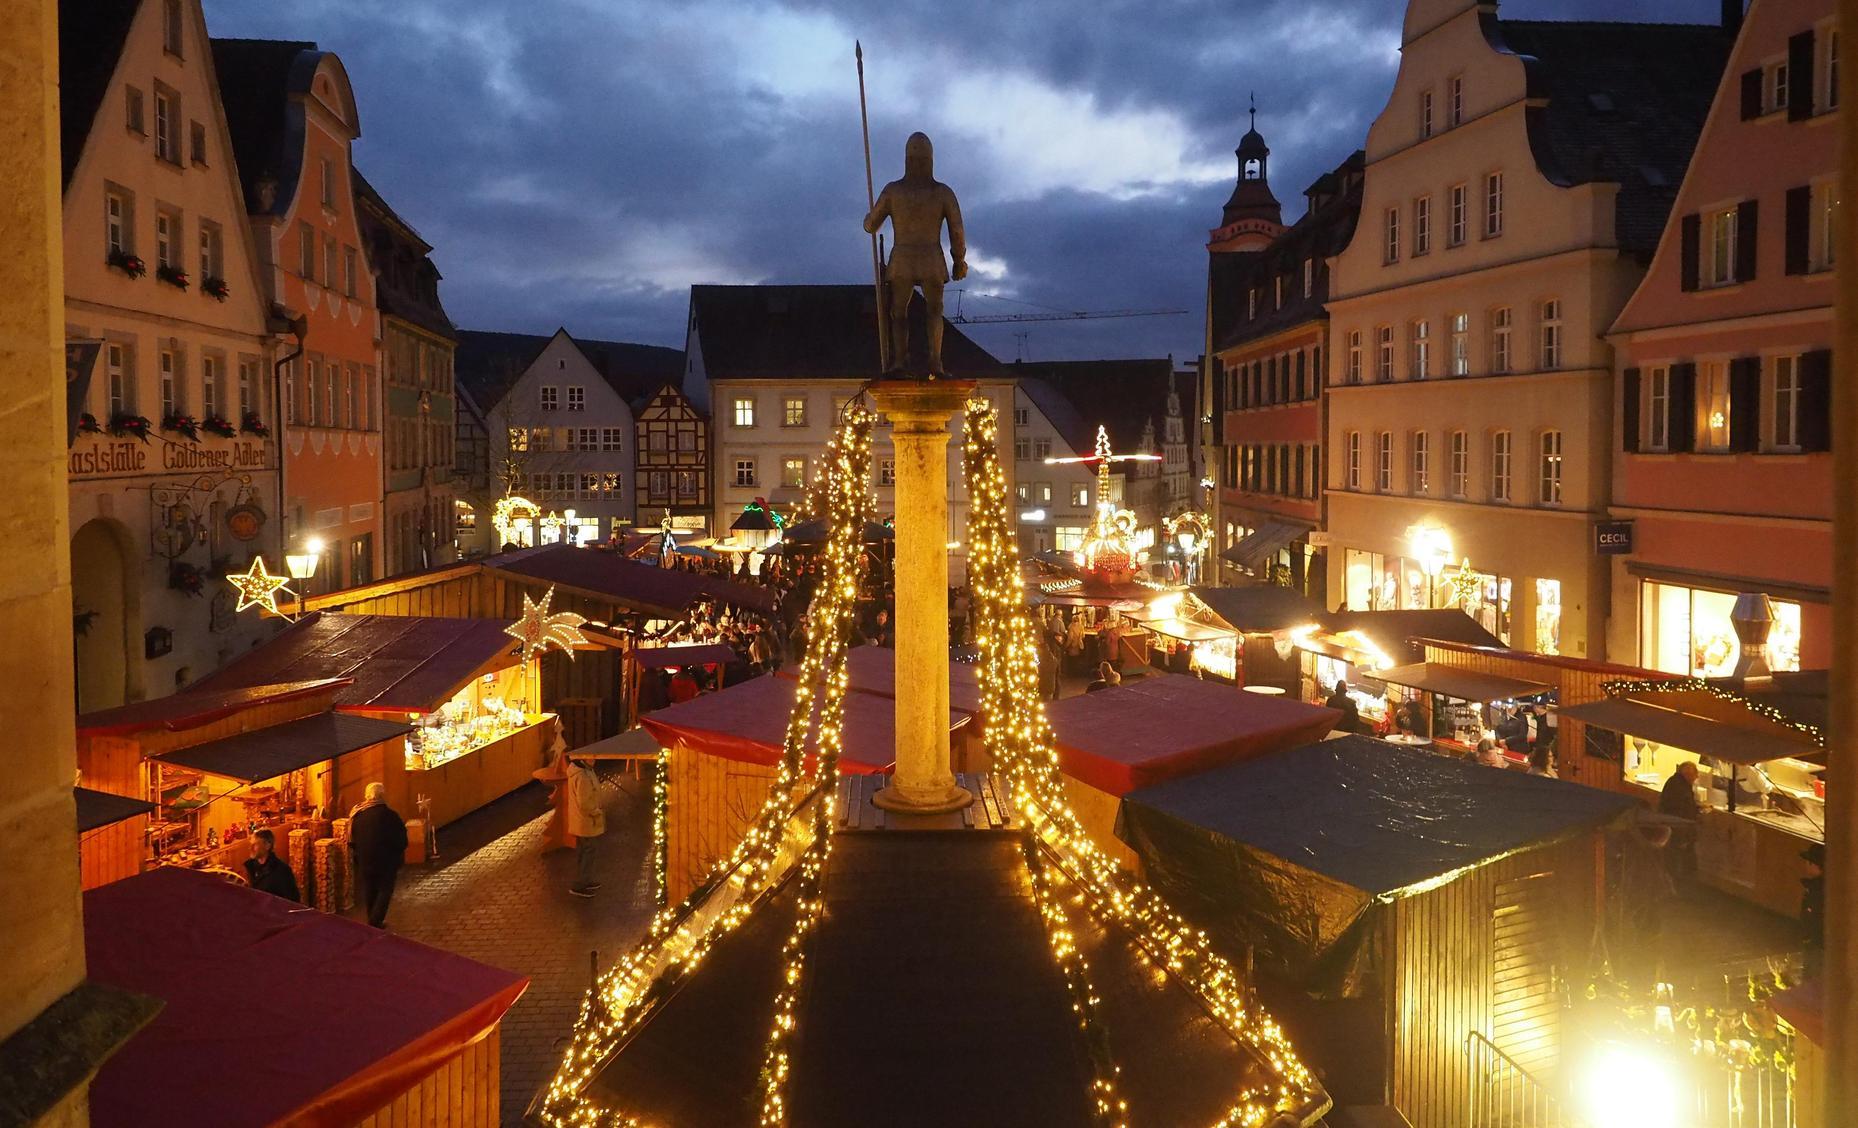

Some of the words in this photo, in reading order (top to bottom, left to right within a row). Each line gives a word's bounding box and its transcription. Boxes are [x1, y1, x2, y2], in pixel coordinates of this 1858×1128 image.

[68, 442, 146, 474] aststätte
[162, 440, 229, 470] Goldener
[232, 441, 266, 467] Adler
[1600, 533, 1628, 543] CECIL
